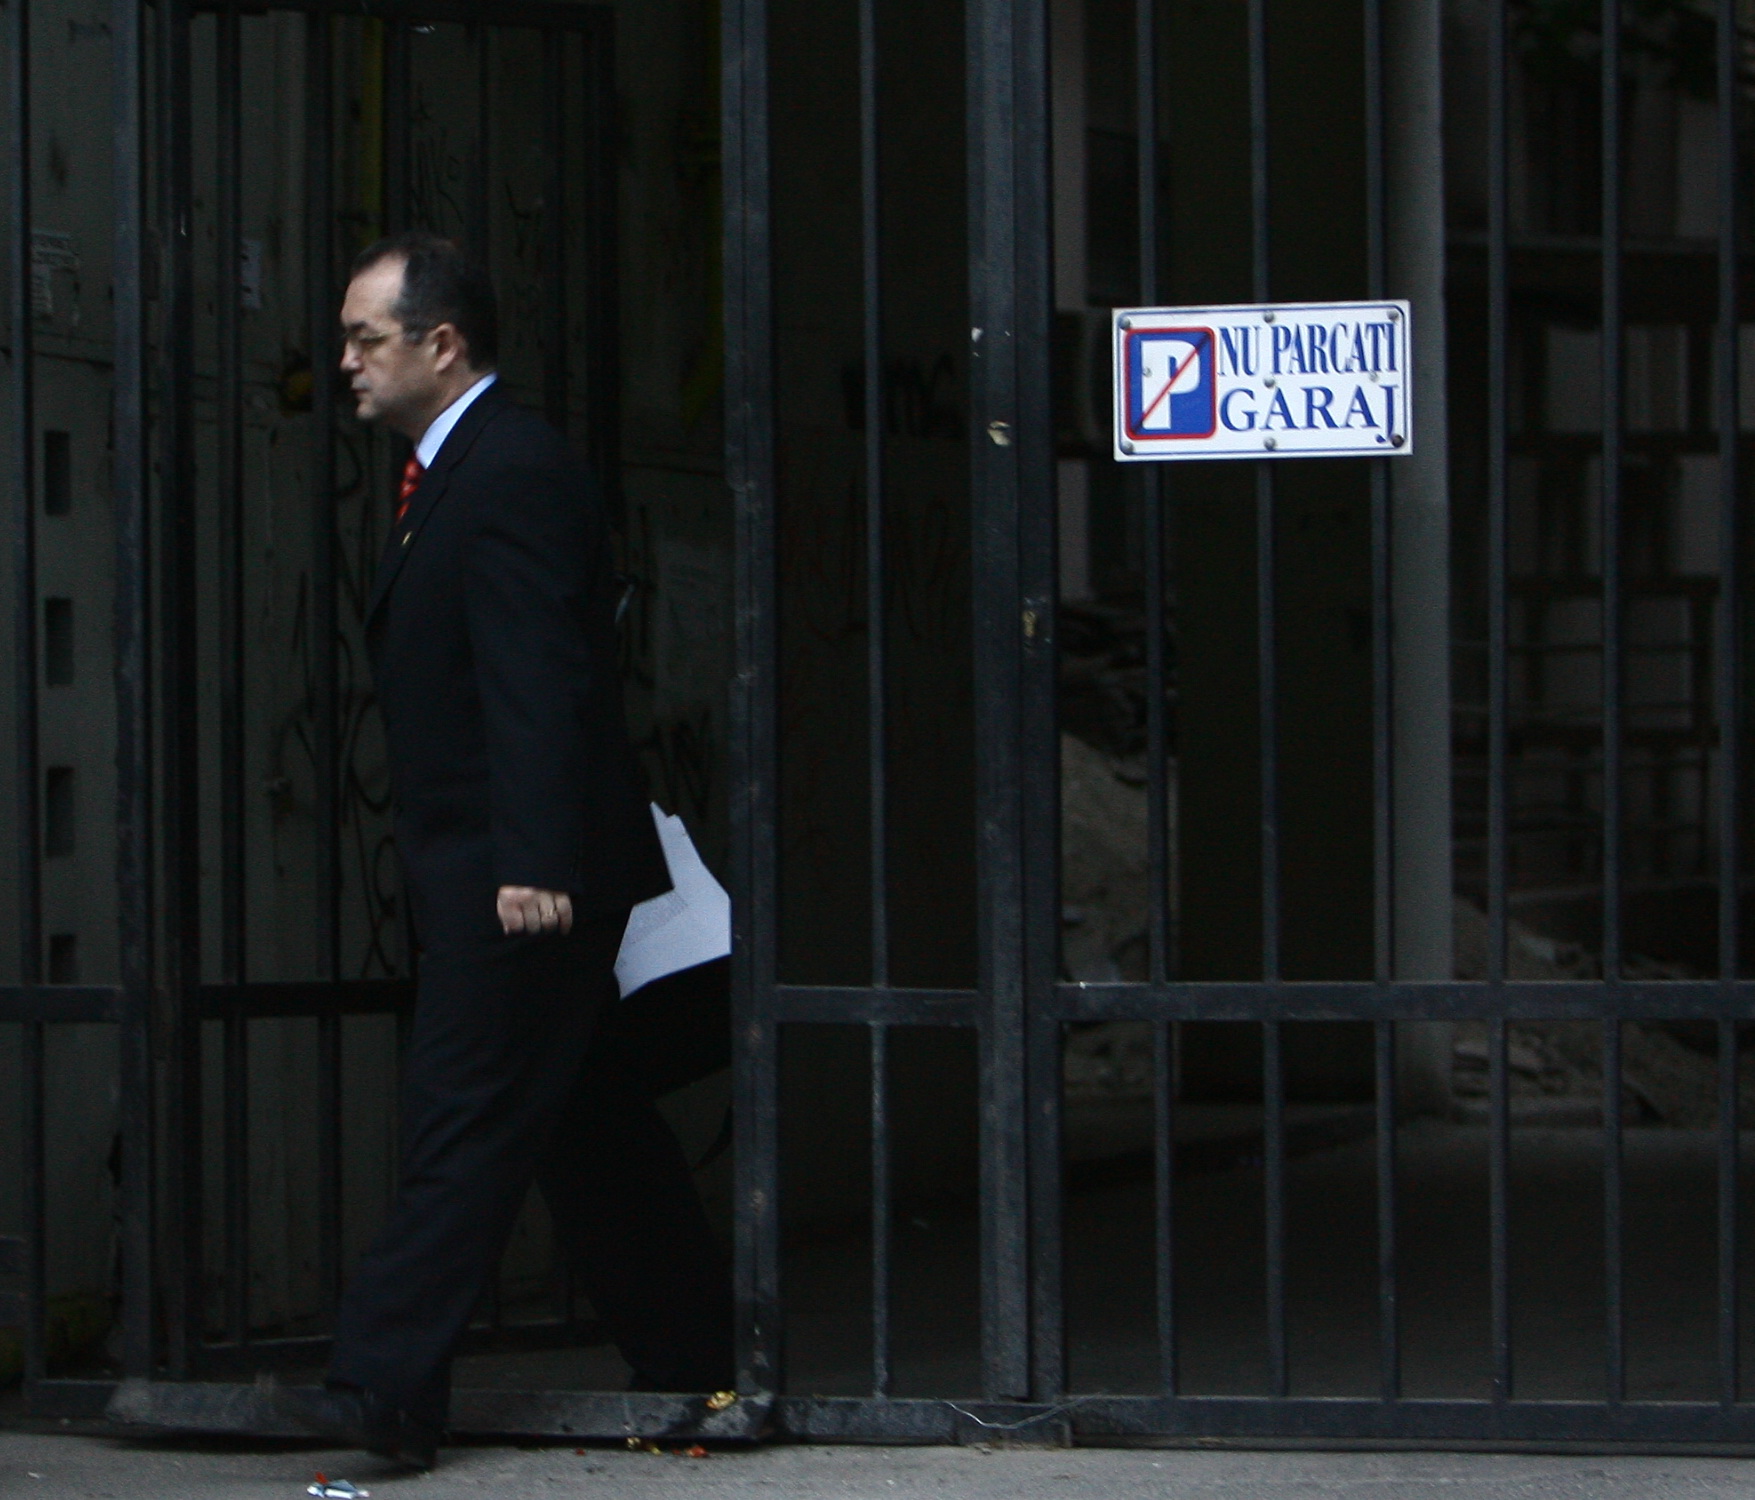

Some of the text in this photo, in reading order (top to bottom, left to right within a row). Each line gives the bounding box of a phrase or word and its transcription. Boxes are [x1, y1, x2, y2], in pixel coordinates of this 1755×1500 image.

[1217, 326, 1260, 377] NU
[1140, 339, 1200, 430] P
[1219, 384, 1399, 443] GARAJ
